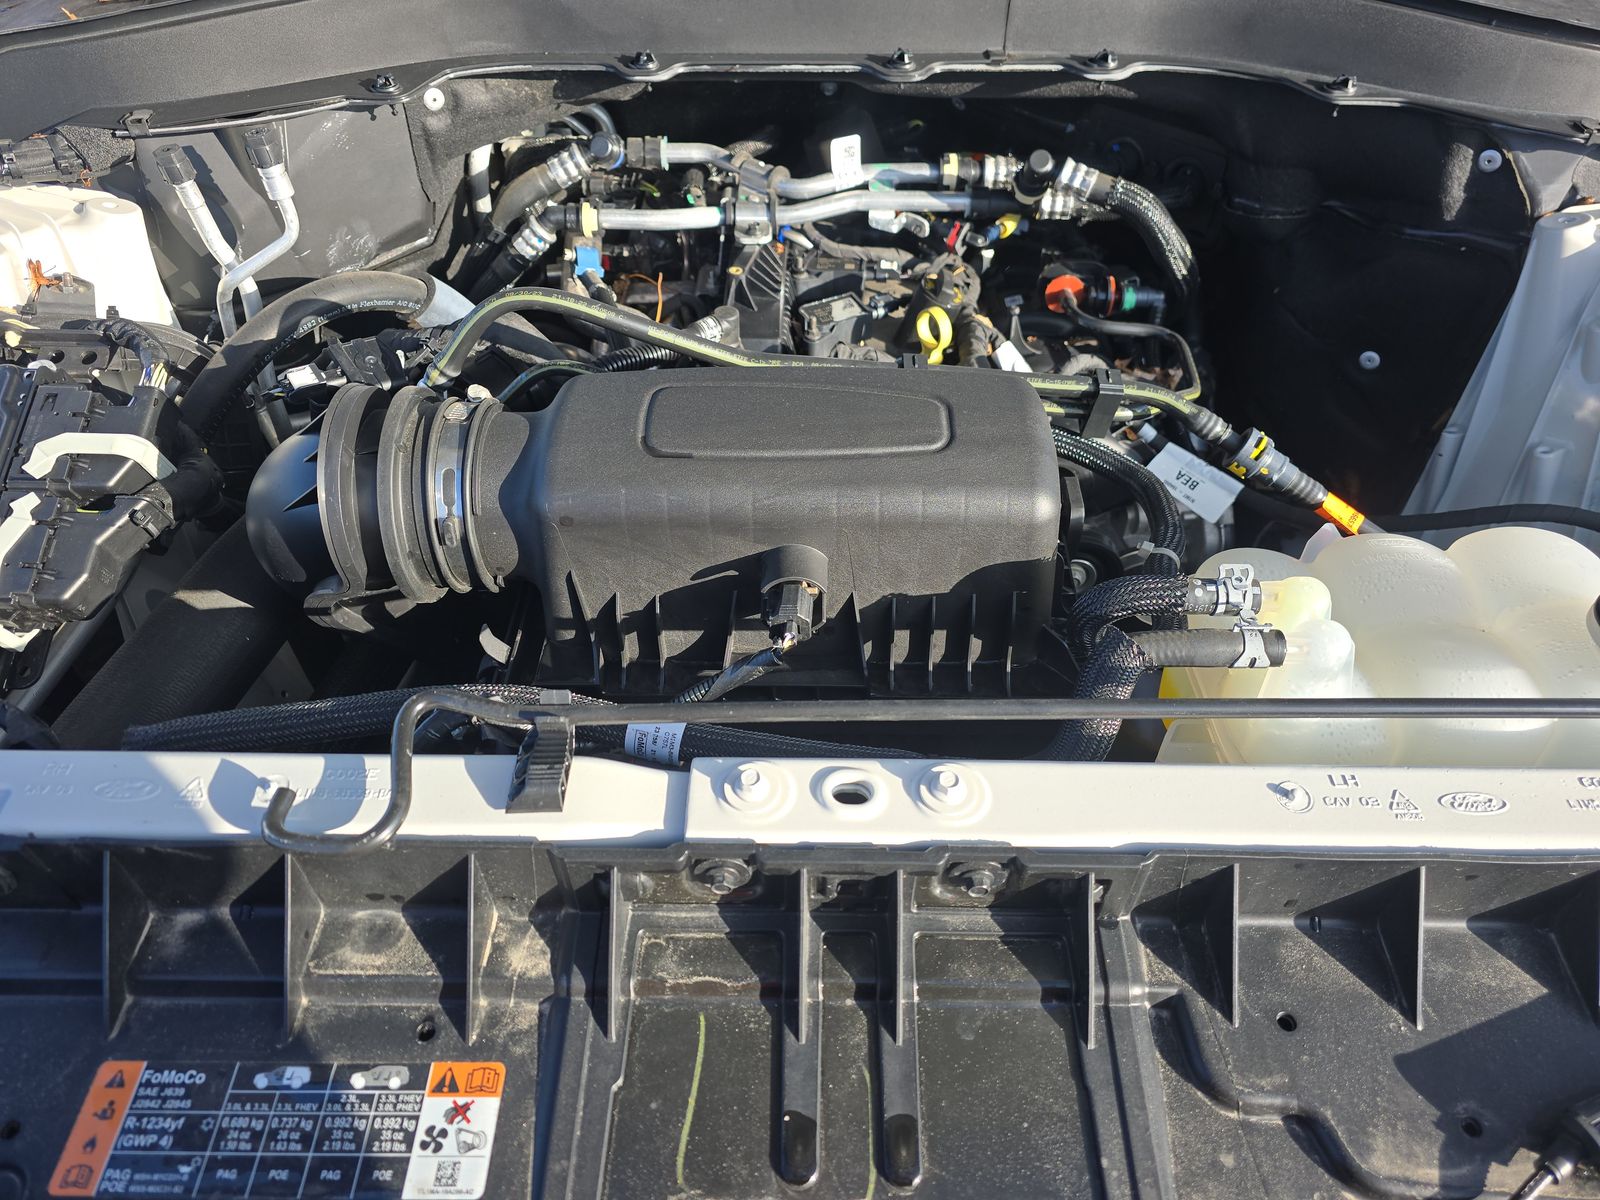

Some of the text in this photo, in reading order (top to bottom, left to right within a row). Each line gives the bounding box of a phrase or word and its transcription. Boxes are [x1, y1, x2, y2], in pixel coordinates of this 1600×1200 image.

[1175, 469, 1201, 491] BEA
[1326, 774, 1360, 788] LH
[142, 1069, 206, 1085] FoMoCo
[137, 1087, 160, 1097] SAE
[124, 1116, 186, 1132] R-1234yf
[250, 1116, 264, 1131] kg
[271, 1116, 314, 1132] 0.737 kg
[324, 1116, 367, 1132] 0.992 kg
[373, 1117, 417, 1132] 0.992 kg
[331, 1129, 354, 1140] 35 oz
[380, 1129, 405, 1141] 35 oz
[117, 1135, 174, 1150] (GWP 4)
[342, 1141, 356, 1151] lbs
[372, 1141, 407, 1152] 2.19 lbs
[104, 1168, 132, 1181] PAG
[216, 1168, 238, 1180] PAG
[268, 1169, 290, 1181] POE
[320, 1169, 342, 1181] PAG
[372, 1169, 394, 1181] POE
[100, 1181, 127, 1193] POE
